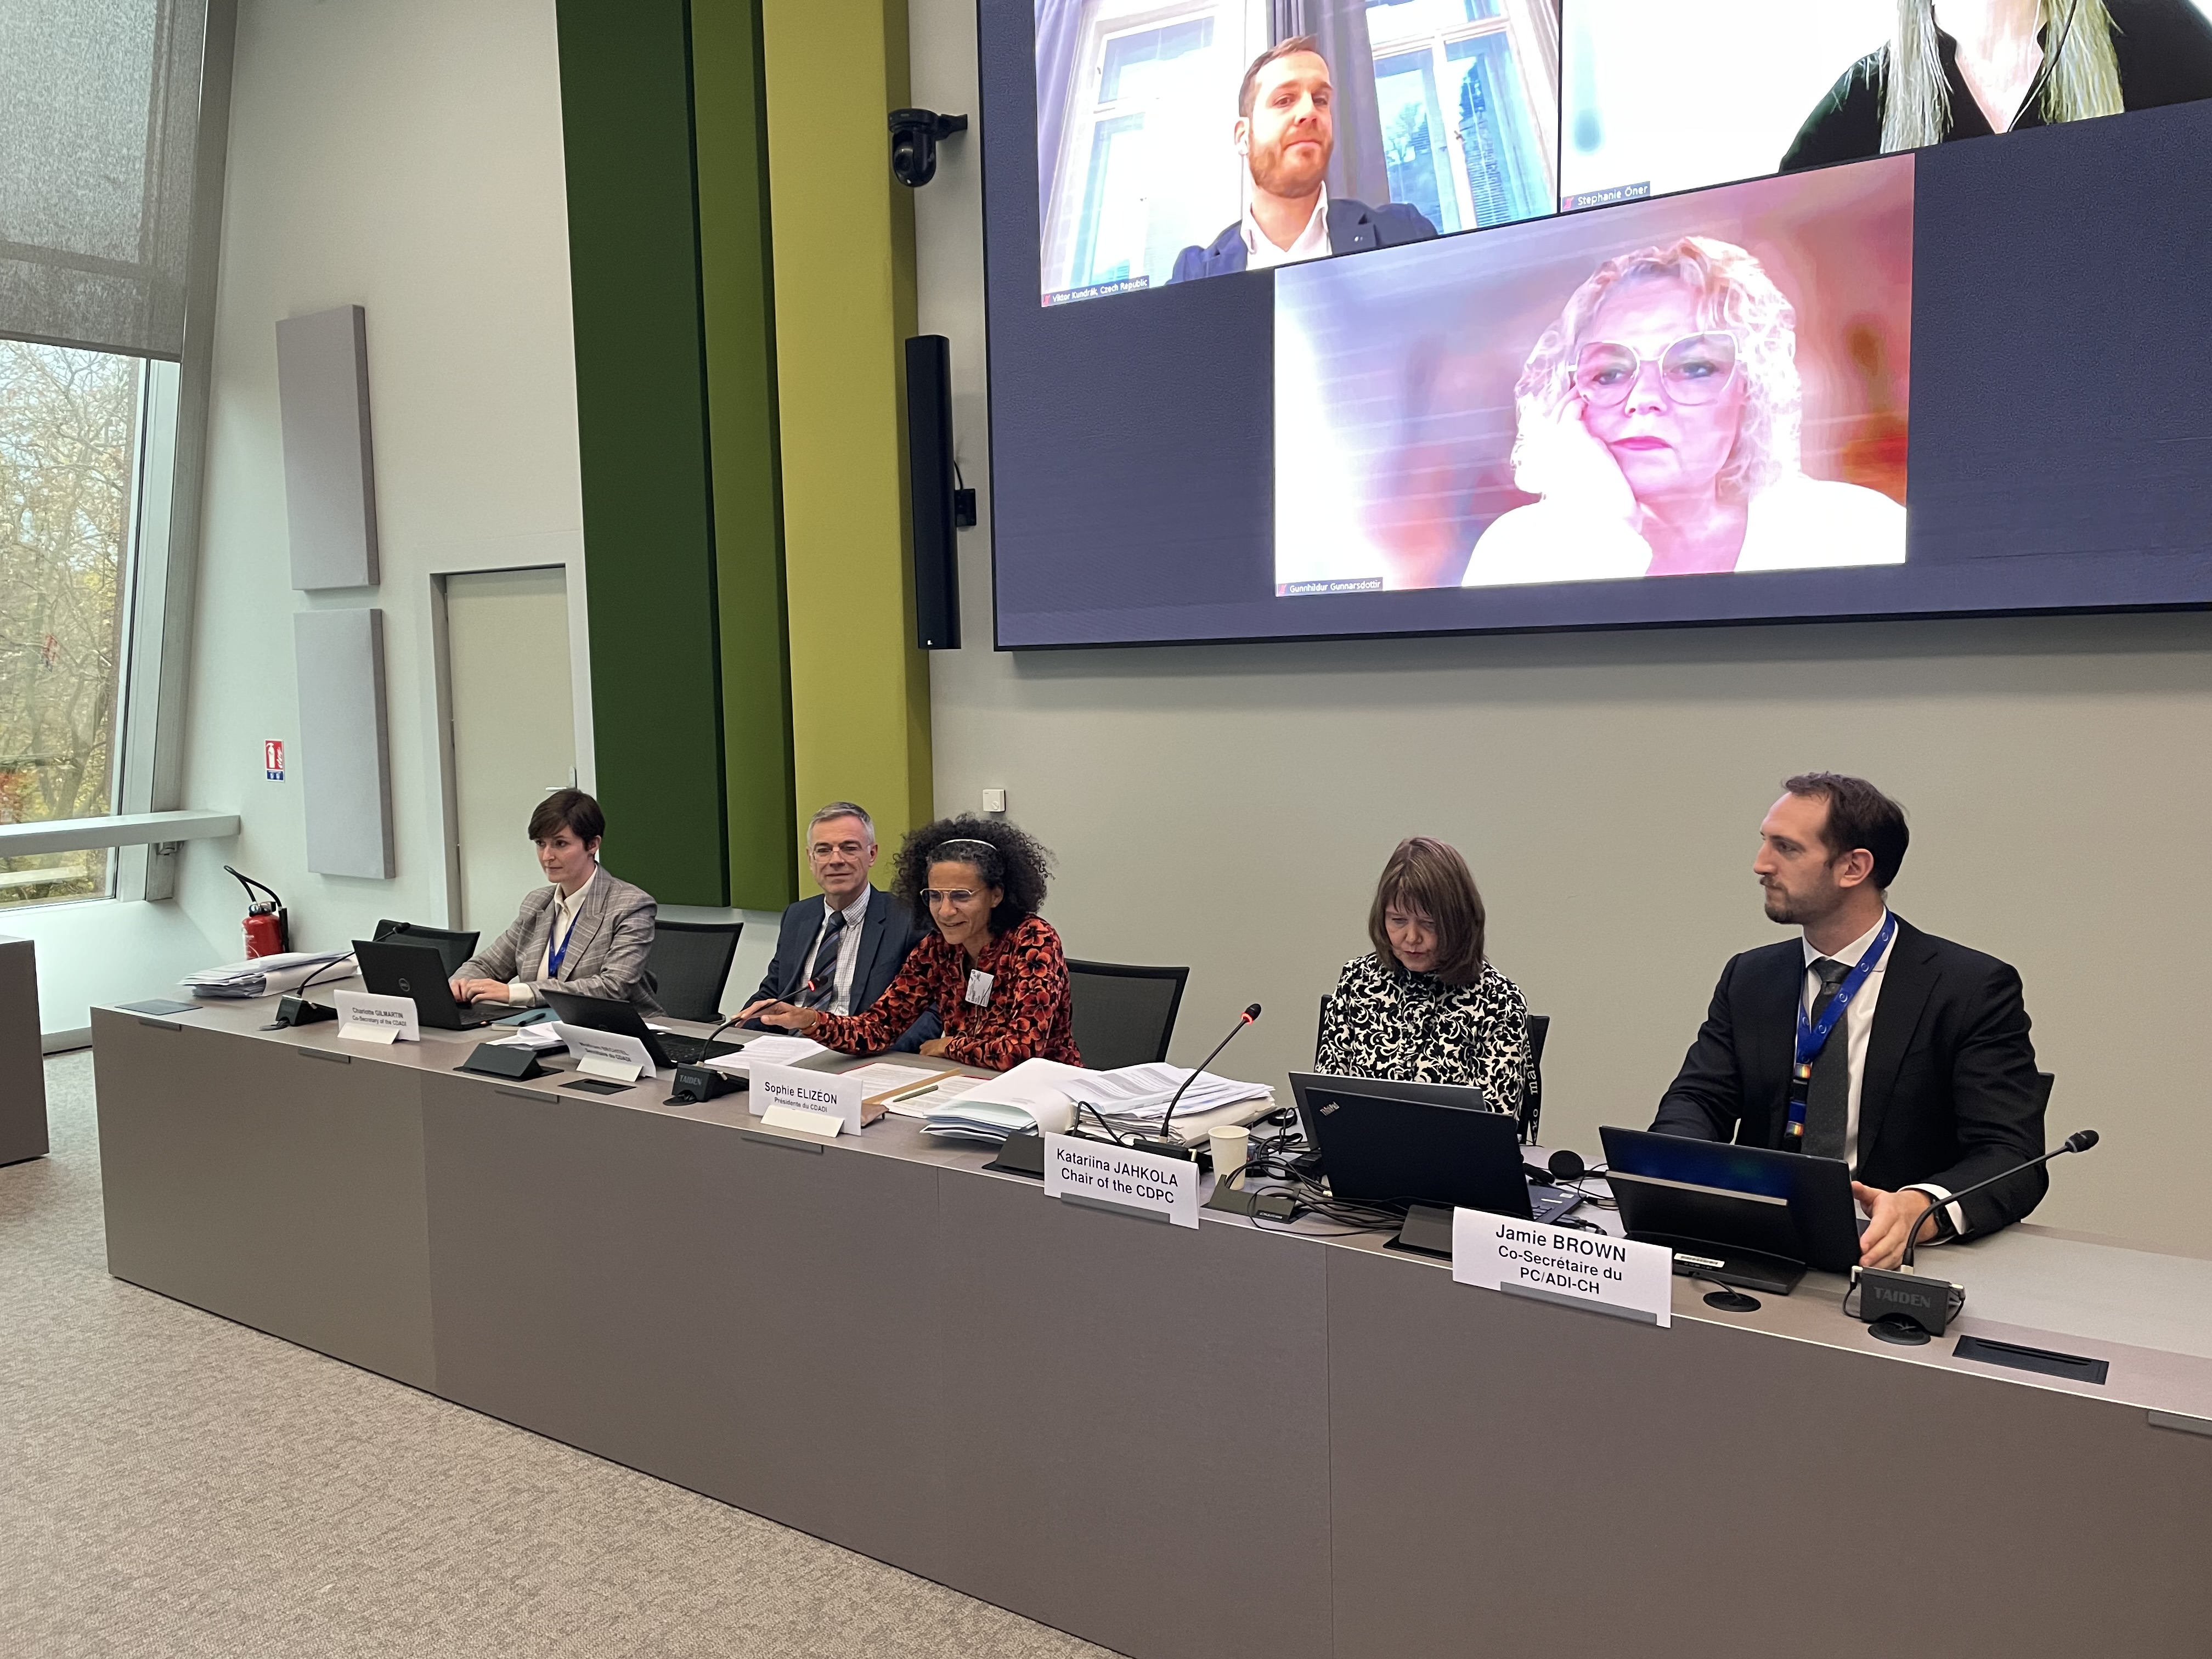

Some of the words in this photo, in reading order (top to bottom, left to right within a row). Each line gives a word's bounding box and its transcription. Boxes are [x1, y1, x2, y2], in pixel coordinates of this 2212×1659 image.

[1578, 189, 1622, 206] Stephanie
[1624, 185, 1648, 197] Öner
[1052, 293, 1070, 302] Viktor
[1100, 283, 1118, 294] Czech
[1120, 278, 1148, 290] Republic
[1289, 583, 1328, 593] Gunnhildur
[352, 1007, 374, 1015] Charlotte
[375, 1010, 403, 1018] GILMARTIN
[680, 1075, 702, 1085] TAIDEN
[765, 1082, 794, 1096] Sophie
[797, 1087, 838, 1104] ELIZÉON
[774, 1097, 801, 1108] Présidente
[810, 1104, 827, 1113] CDADI
[1057, 1148, 1110, 1171] Katariina
[1114, 1162, 1178, 1187] JAHKOLA
[1061, 1167, 1093, 1185] Chair
[1097, 1178, 1109, 1189] of
[1113, 1180, 1132, 1194] the
[1136, 1185, 1174, 1204] CDPC
[1496, 1224, 1547, 1246] Jamie
[1553, 1234, 1626, 1262] BROWN
[1498, 1245, 1599, 1276] Co-Secrétaire
[1603, 1267, 1622, 1281] du
[1520, 1267, 1600, 1295] PC/ADI-CH
[1873, 1286, 1932, 1308] TAIDEN
